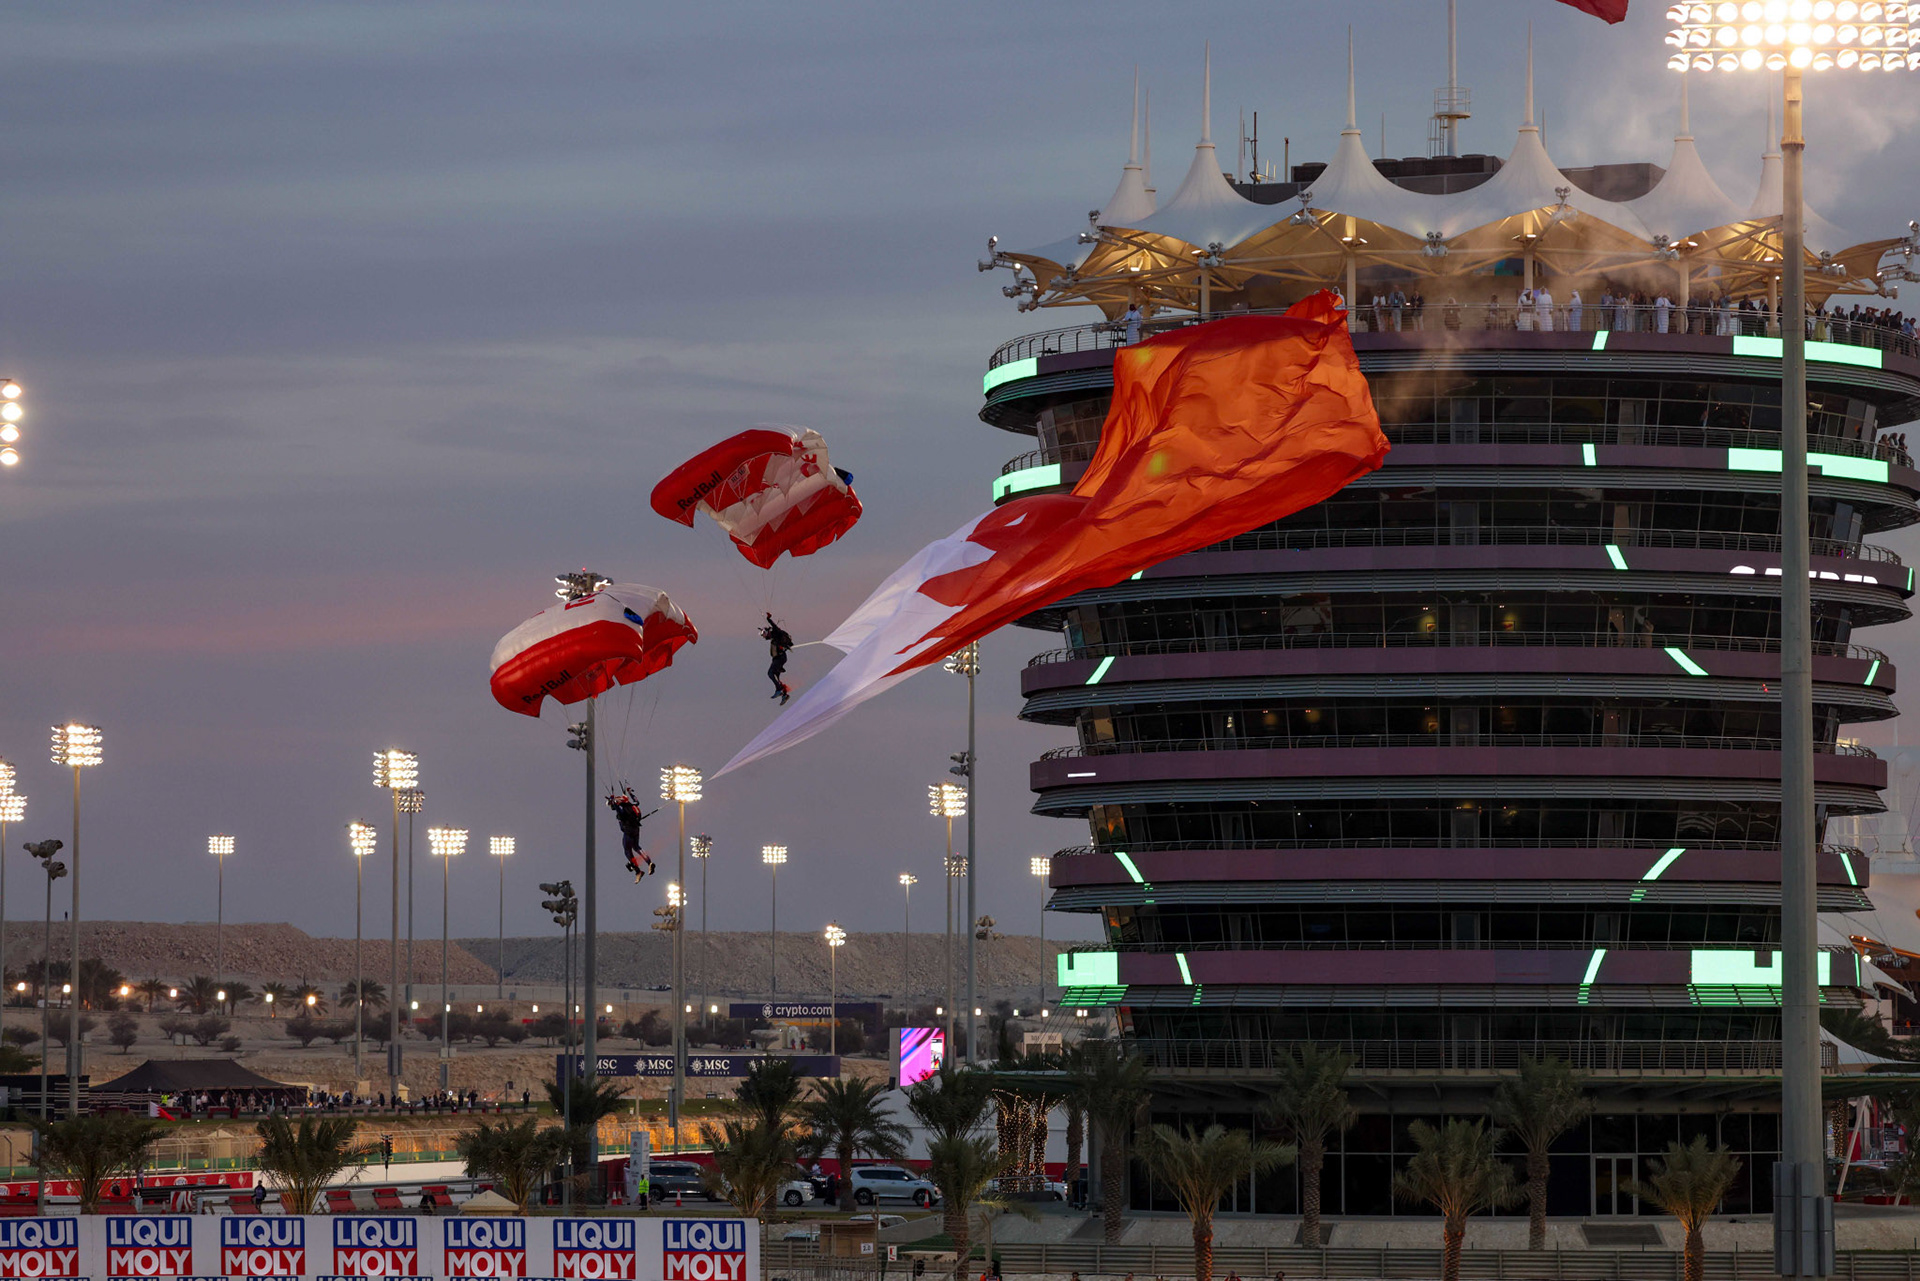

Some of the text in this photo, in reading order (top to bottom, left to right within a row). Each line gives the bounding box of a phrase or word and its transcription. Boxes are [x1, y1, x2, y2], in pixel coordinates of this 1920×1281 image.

[677, 487, 701, 510] Red
[698, 470, 722, 495] Bull
[546, 669, 572, 690] Bull
[775, 1005, 833, 1017] crypto.com
[648, 1059, 674, 1069] MSC
[704, 1059, 730, 1070] MSC
[0, 1220, 74, 1249] LIQUI
[110, 1219, 188, 1247] LIQUI
[224, 1219, 300, 1247] LIQUI
[337, 1219, 413, 1248] LIQUI
[447, 1220, 522, 1249] LIQUI
[557, 1221, 632, 1250] LIQUI
[666, 1222, 742, 1251] LIQUI
[0, 1250, 77, 1277] MOLY
[110, 1249, 191, 1276] MOLY
[225, 1249, 304, 1276] MOLY
[337, 1249, 416, 1276] MOLY
[449, 1250, 525, 1277] MOLY
[557, 1252, 635, 1279] MOLY
[667, 1253, 745, 1281] MOLY
